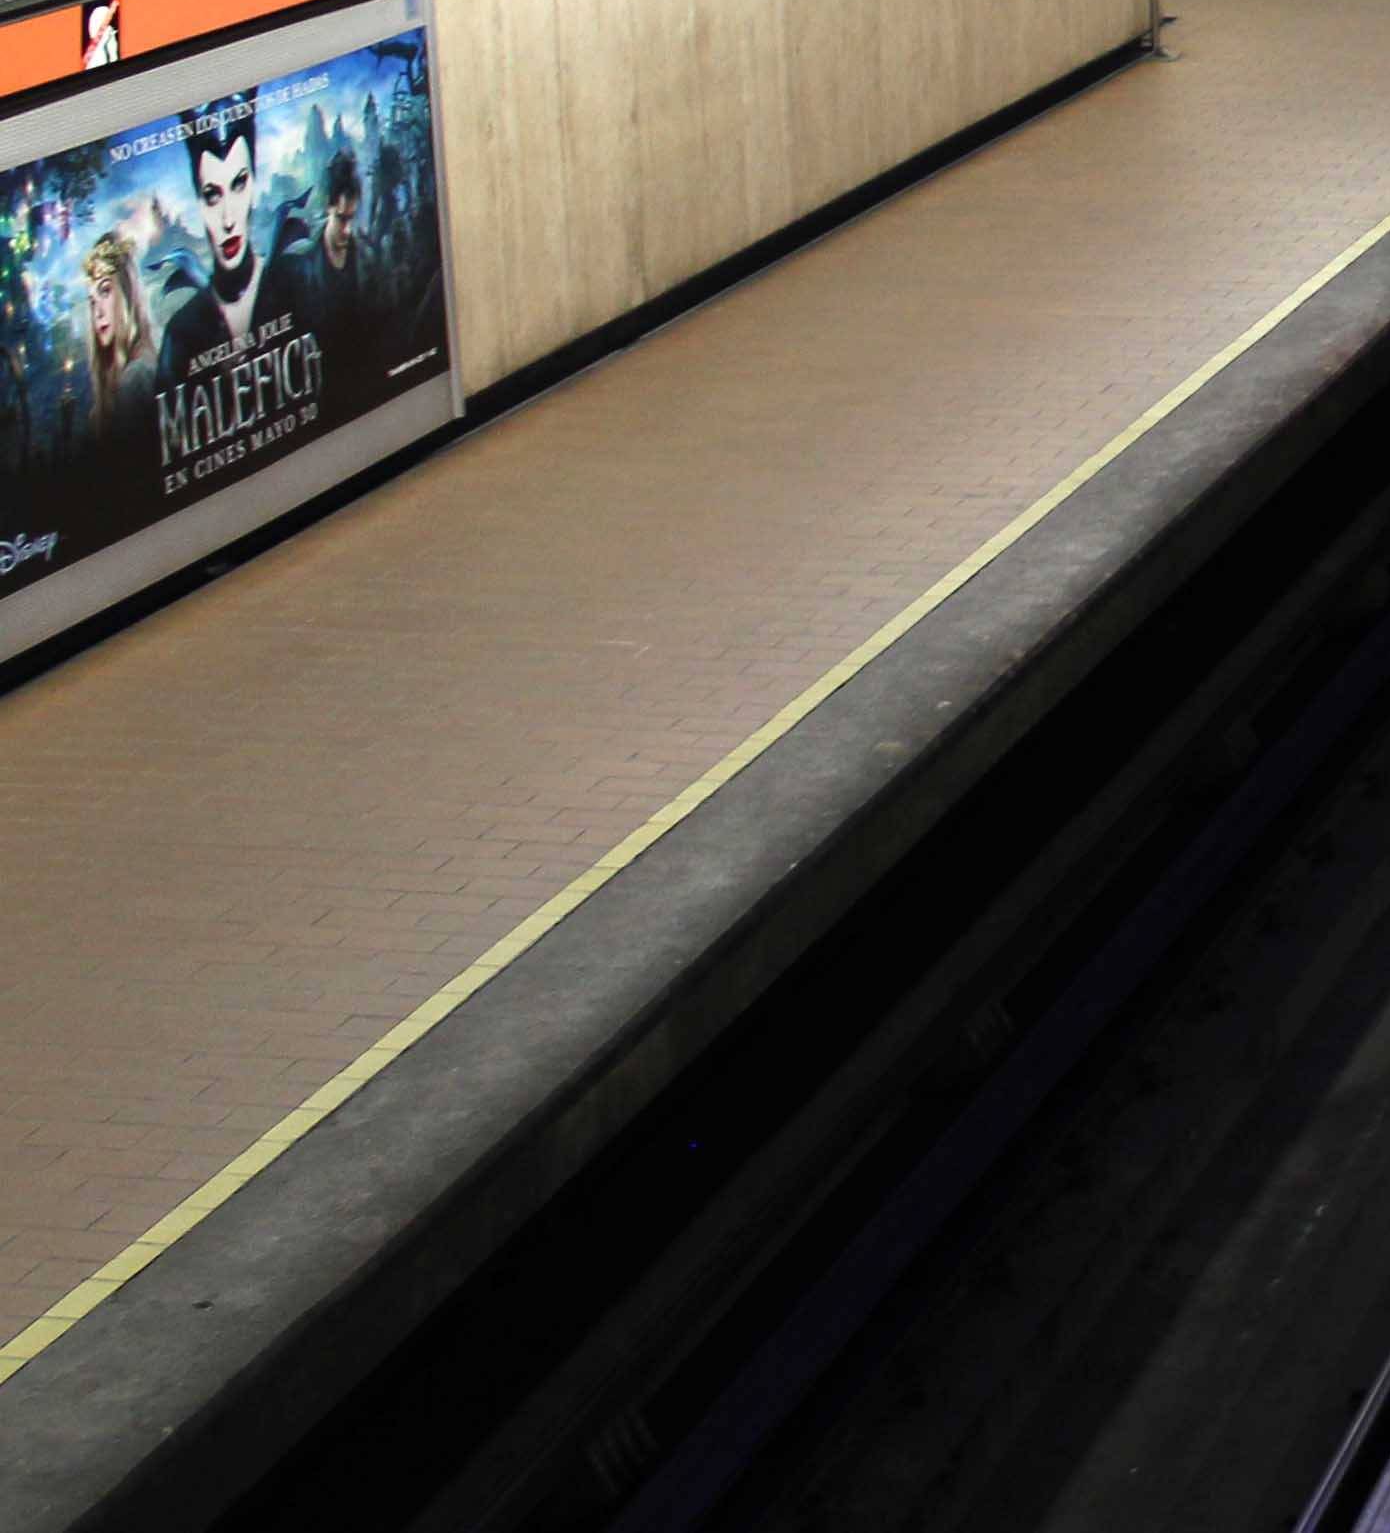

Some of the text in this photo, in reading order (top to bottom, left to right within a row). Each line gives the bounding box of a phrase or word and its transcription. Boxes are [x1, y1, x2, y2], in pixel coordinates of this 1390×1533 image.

[110, 143, 132, 164] NO
[132, 127, 176, 156] CREAS
[189, 312, 294, 376] ANGELINA JOLIE
[155, 332, 323, 467] MALÉFICA
[165, 467, 189, 495] EN
[194, 439, 246, 479] CINES
[250, 414, 297, 452] MAYO
